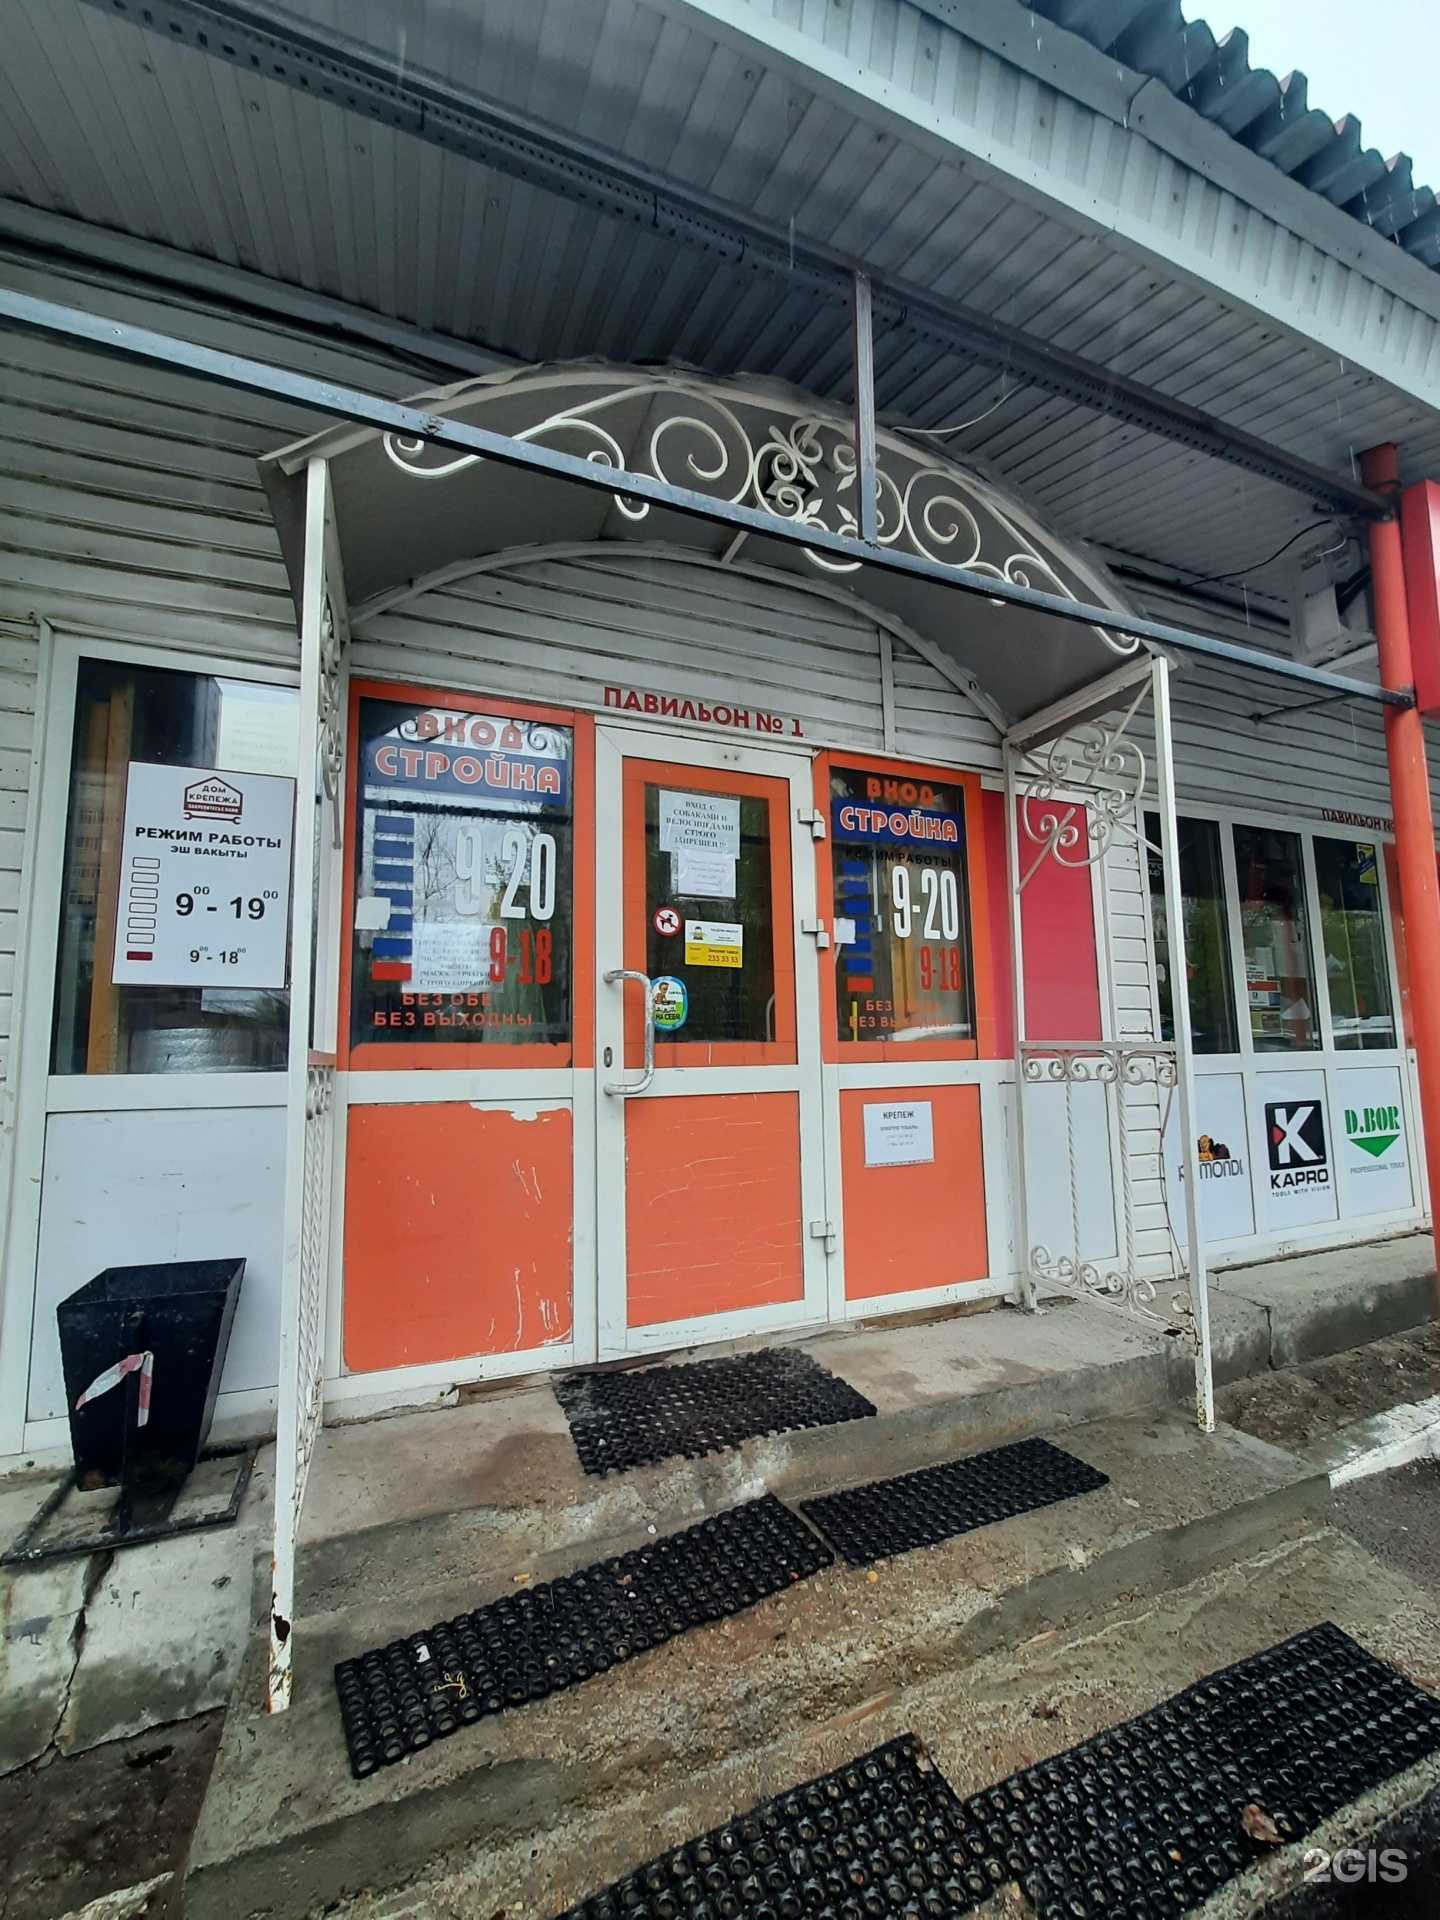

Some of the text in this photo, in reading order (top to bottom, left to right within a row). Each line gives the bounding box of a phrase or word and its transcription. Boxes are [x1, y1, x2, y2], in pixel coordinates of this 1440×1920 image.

[604, 686, 749, 729] ПАВИЛЬОН
[791, 718, 804, 737] 1
[417, 713, 523, 749] ВХОД
[375, 745, 561, 795] СТРОЙКА
[189, 793, 238, 804] КРЕПЕЖА
[202, 785, 226, 793] ДОМ
[840, 806, 958, 843] СТРОЙКА
[1320, 808, 1381, 831] ПАВИЛЬОН
[135, 827, 282, 849] РЕЖИМ РАБОТЫ
[170, 845, 248, 858] ЭШ ВАКЫТЫ
[898, 853, 952, 867] РАБОТЫ
[402, 992, 443, 1007] БЕЗ
[865, 1000, 893, 1012] БЕЗ
[373, 1011, 416, 1027] БЕЗ
[882, 1110, 915, 1120] КРЕПЕЖ
[1344, 1105, 1400, 1134] D.BOR
[1270, 1168, 1329, 1190] KAPRO
